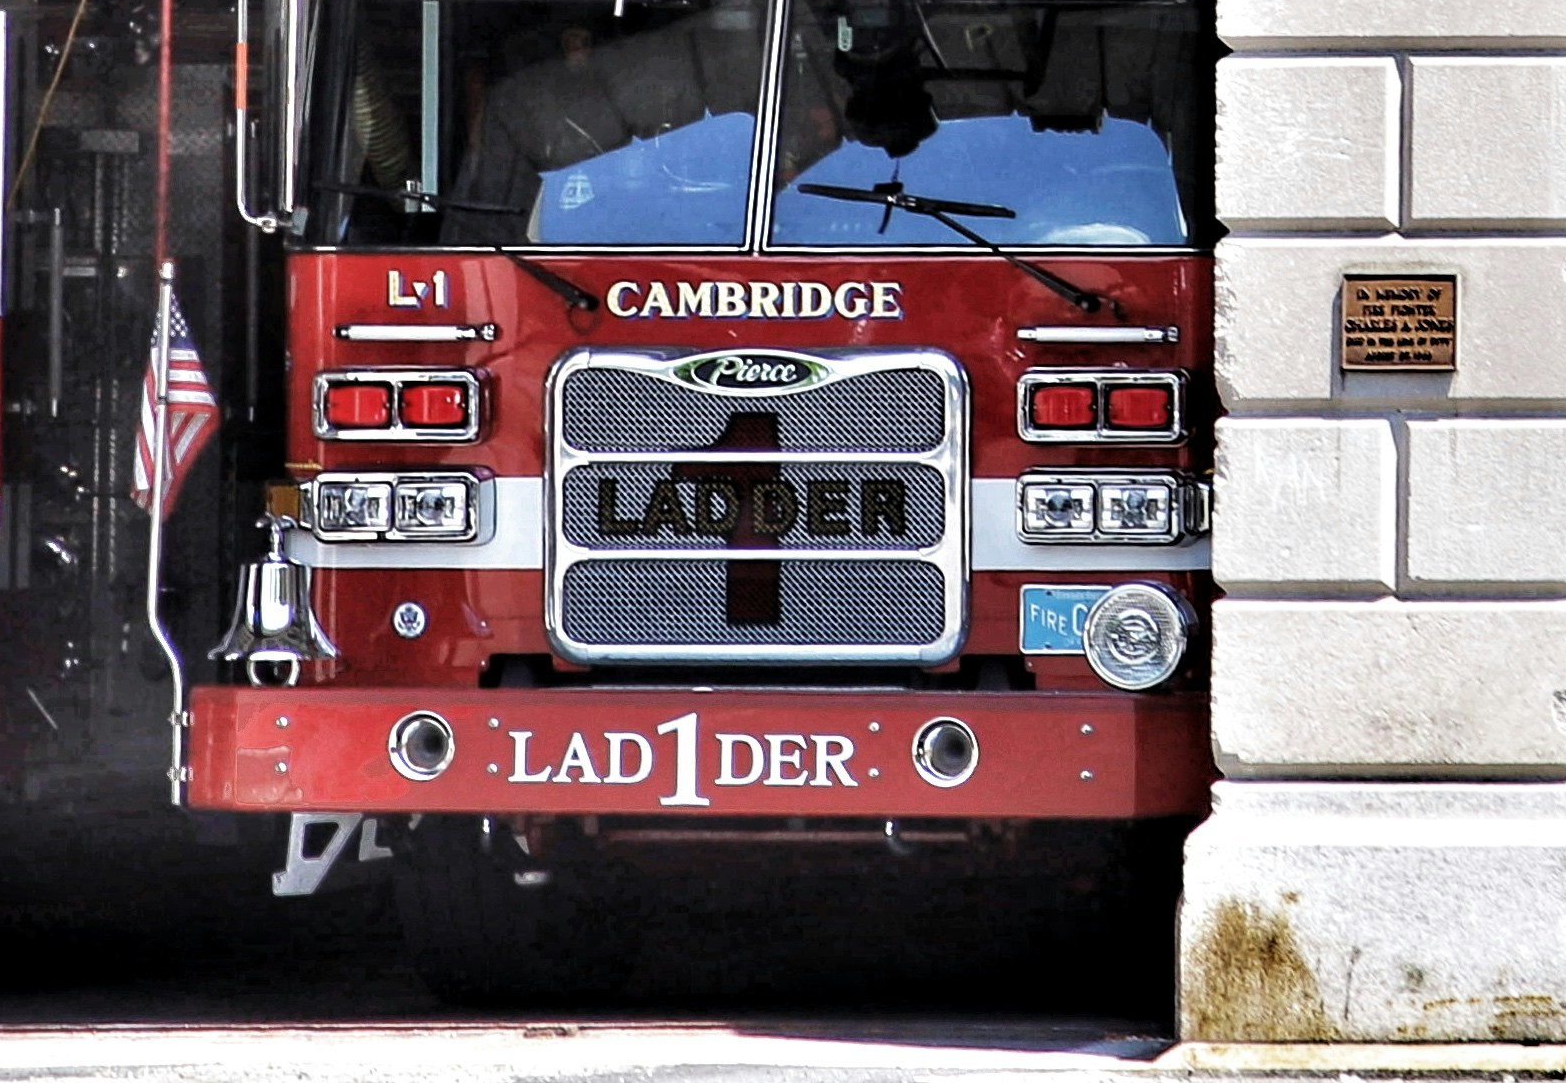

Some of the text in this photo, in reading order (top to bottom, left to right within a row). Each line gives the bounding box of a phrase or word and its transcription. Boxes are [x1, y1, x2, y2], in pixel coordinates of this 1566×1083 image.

[605, 281, 905, 319] CAMBRIDGE
[709, 356, 798, 386] Pierce
[596, 477, 906, 537] LADDER
[672, 411, 781, 626] 1
[1030, 603, 1069, 636] FIRE
